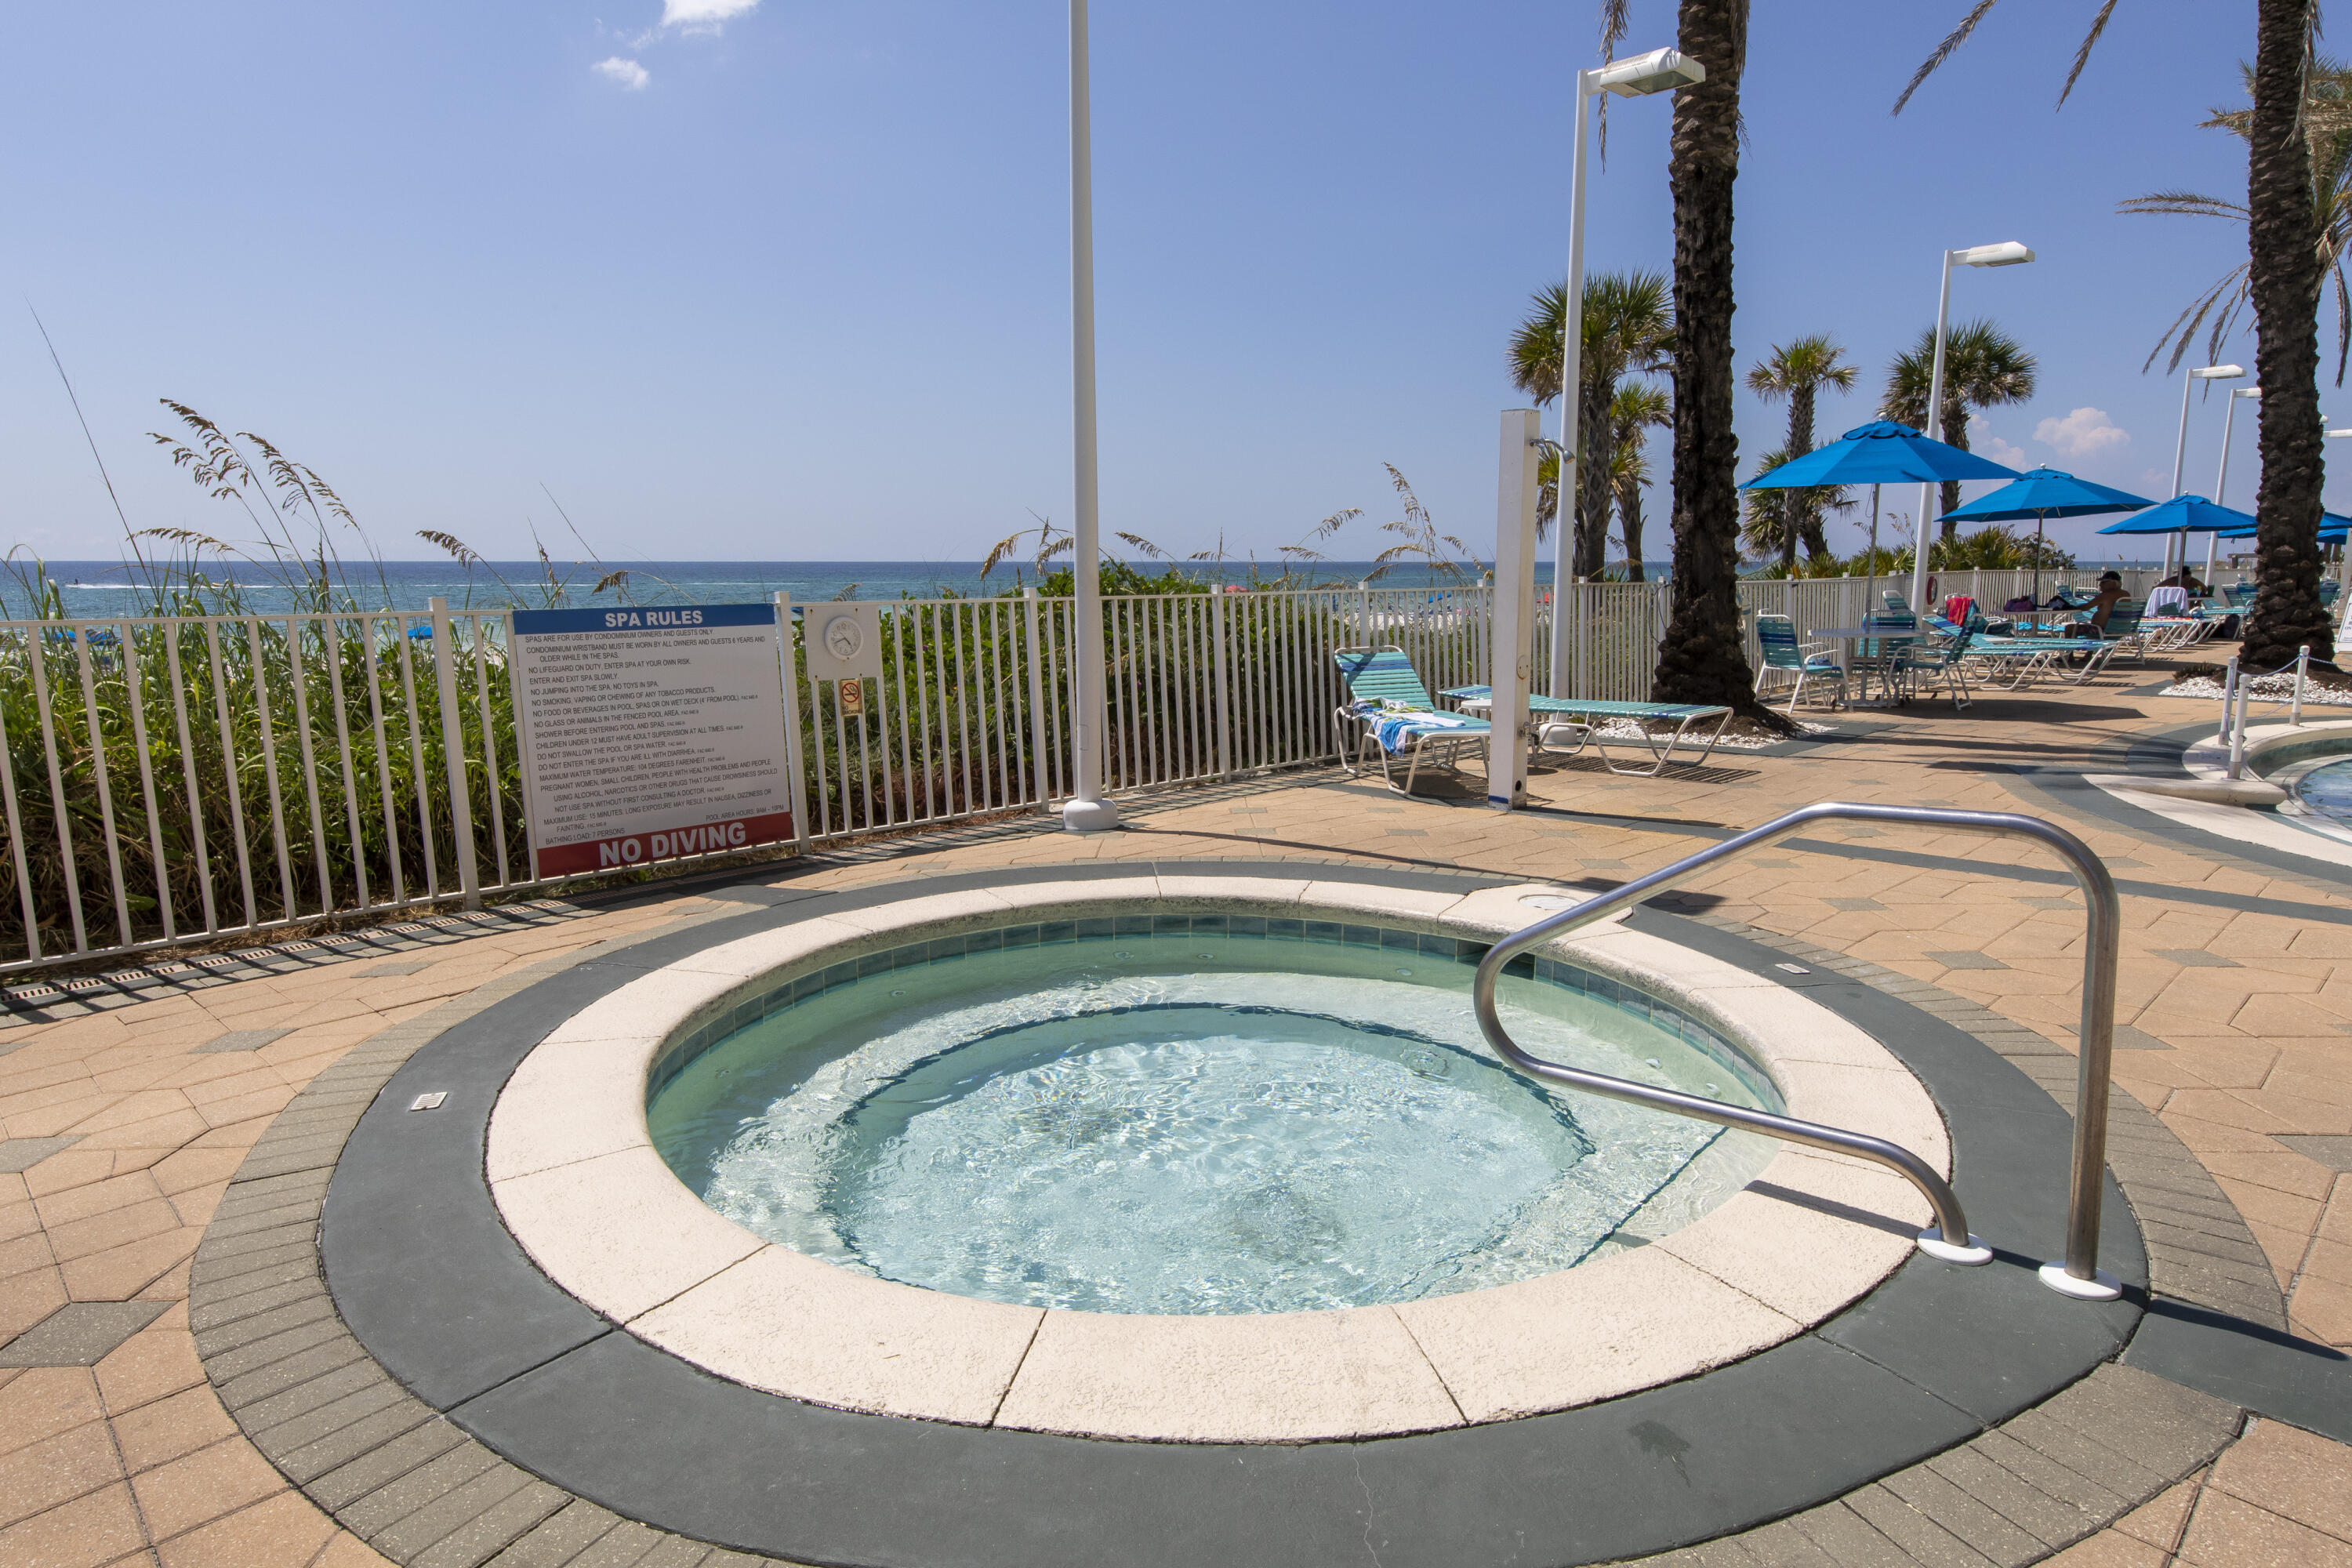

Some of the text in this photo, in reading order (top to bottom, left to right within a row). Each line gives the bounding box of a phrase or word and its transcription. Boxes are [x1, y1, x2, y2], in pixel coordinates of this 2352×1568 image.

[605, 611, 703, 627] SPA RULES
[572, 705, 608, 713] BEVERAGES
[576, 716, 602, 724] ANIMALS
[535, 730, 562, 739] SHOWER
[563, 728, 587, 736] BEFORE
[589, 725, 619, 734] ENTERING
[535, 740, 567, 750] CHILDREN
[568, 738, 590, 746] UNDER
[652, 728, 688, 738] SUPERVISION
[561, 748, 593, 757] SWALLOW
[539, 771, 568, 781] MAXIMUM
[569, 769, 591, 778] WATER
[648, 760, 674, 769] DEGREES
[539, 782, 573, 792] PREGNANT
[600, 776, 619, 785] SMALL
[651, 770, 673, 779] PEOPLE
[710, 763, 739, 771] PROBLEMS
[554, 793, 572, 801] USING
[604, 785, 637, 795] NARCOTICS
[595, 798, 622, 808] WITHOUT
[543, 815, 572, 826] MAXIMUM
[642, 802, 672, 811] EXPOSURE
[545, 834, 572, 844] BATHING
[597, 827, 624, 837] PERSONS
[600, 822, 746, 866] NO DIVING
